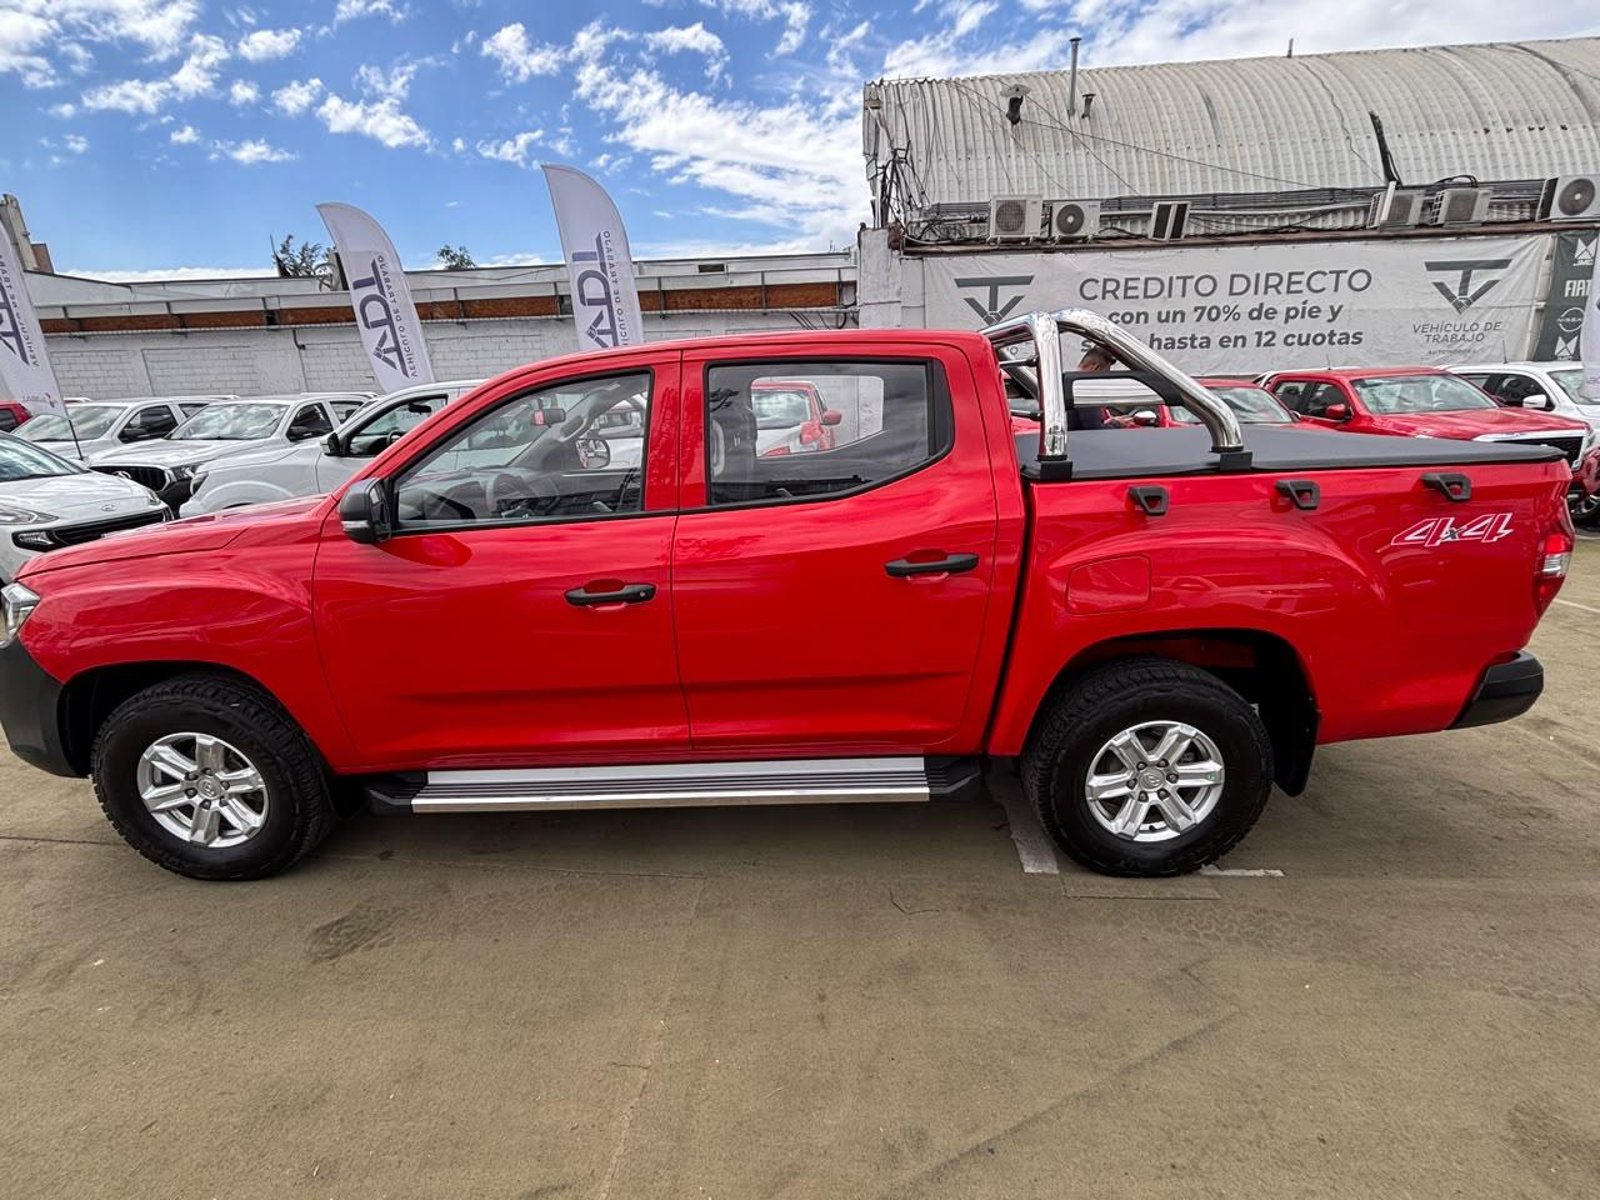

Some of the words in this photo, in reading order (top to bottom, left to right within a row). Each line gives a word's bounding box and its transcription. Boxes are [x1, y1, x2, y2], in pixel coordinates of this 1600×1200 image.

[1079, 274, 1218, 301] CREDITO
[1228, 268, 1373, 296] DIRECTO
[1108, 309, 1150, 325] con
[1156, 308, 1186, 323] un
[1193, 304, 1241, 322] 70%
[1248, 302, 1278, 321] de
[1326, 304, 1344, 323] y
[1412, 320, 1479, 333] VEHÍCULO
[1483, 321, 1503, 331] DE
[1148, 333, 1211, 351] hasta
[1218, 335, 1247, 349] en
[1254, 330, 1276, 348] 12
[1283, 329, 1364, 347] cuotas
[1424, 332, 1485, 344] TRABAJO
[1390, 512, 1514, 547] 4x4
